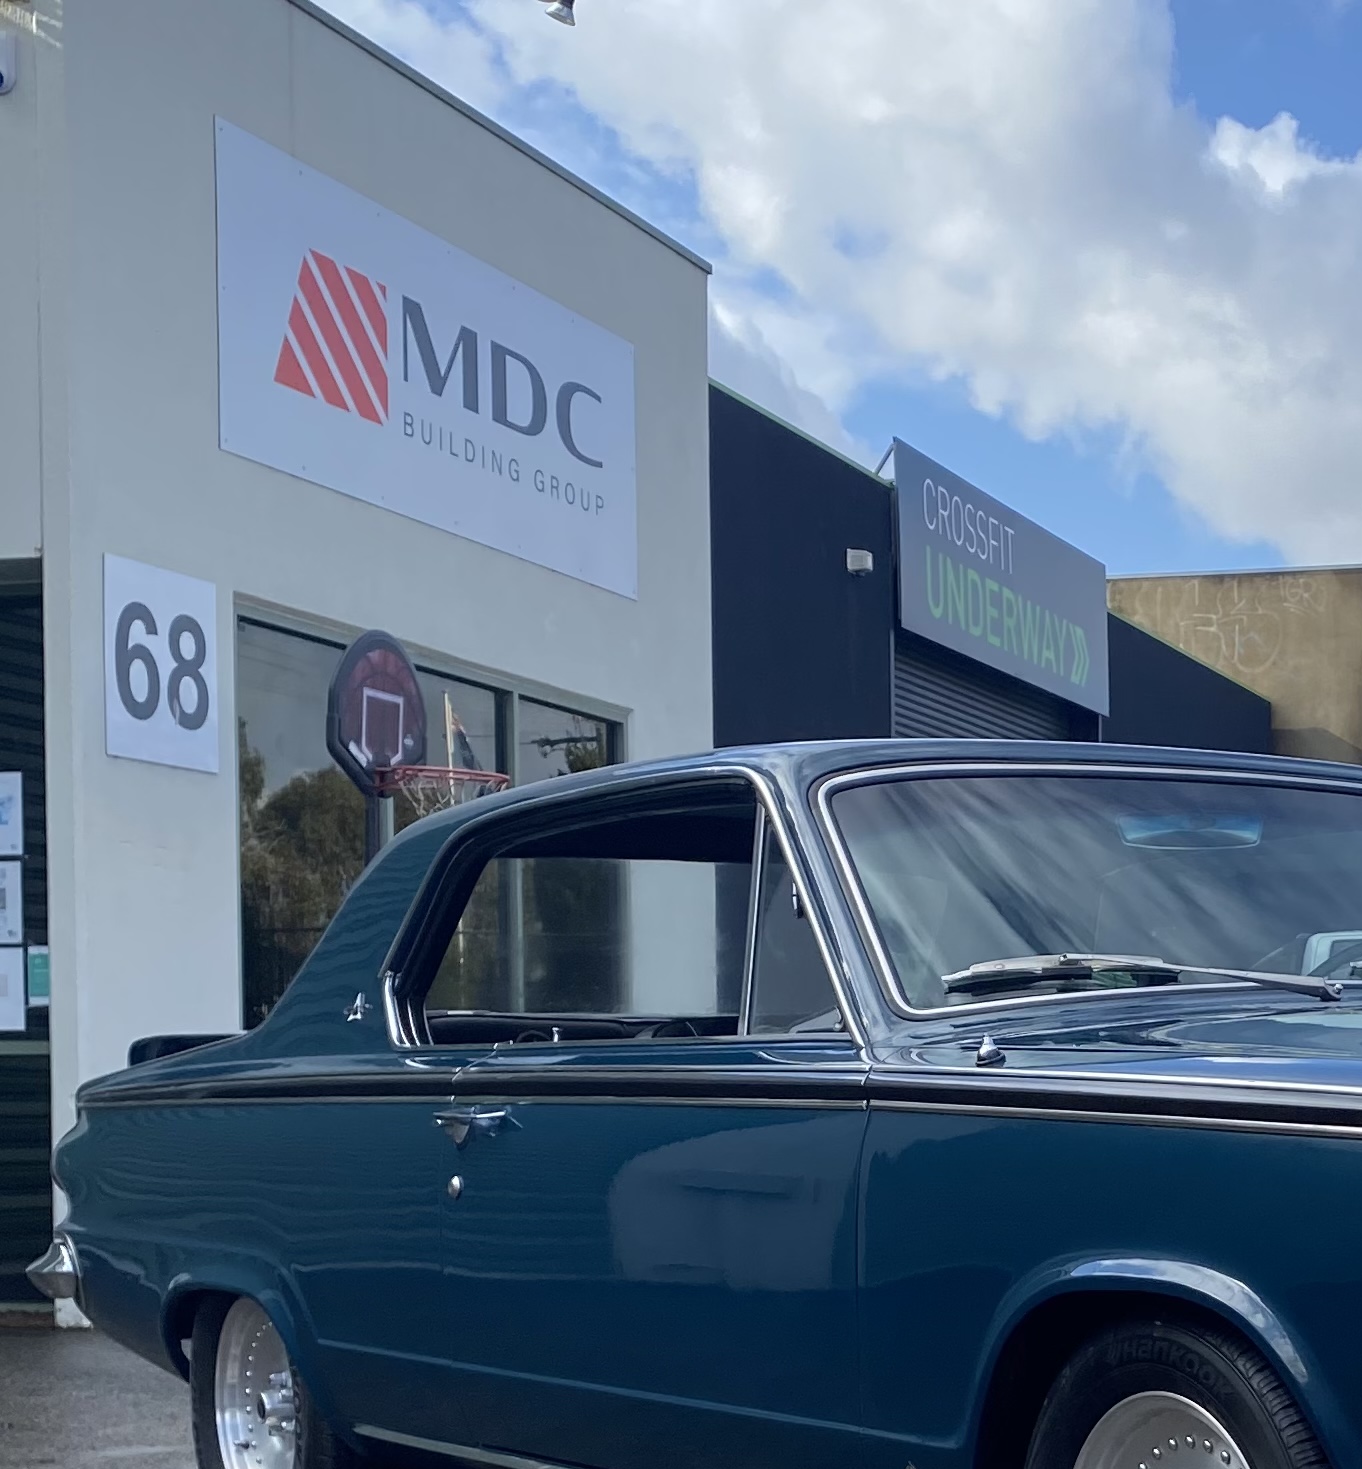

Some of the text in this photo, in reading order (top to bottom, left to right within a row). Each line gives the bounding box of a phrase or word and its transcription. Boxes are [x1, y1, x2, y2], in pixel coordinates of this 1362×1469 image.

[402, 294, 603, 468] MDC
[403, 411, 605, 516] BUILDING GROUP
[923, 478, 1015, 575] CROSSFIT
[115, 601, 209, 731] 68
[925, 544, 1068, 677] UNDERWAY
